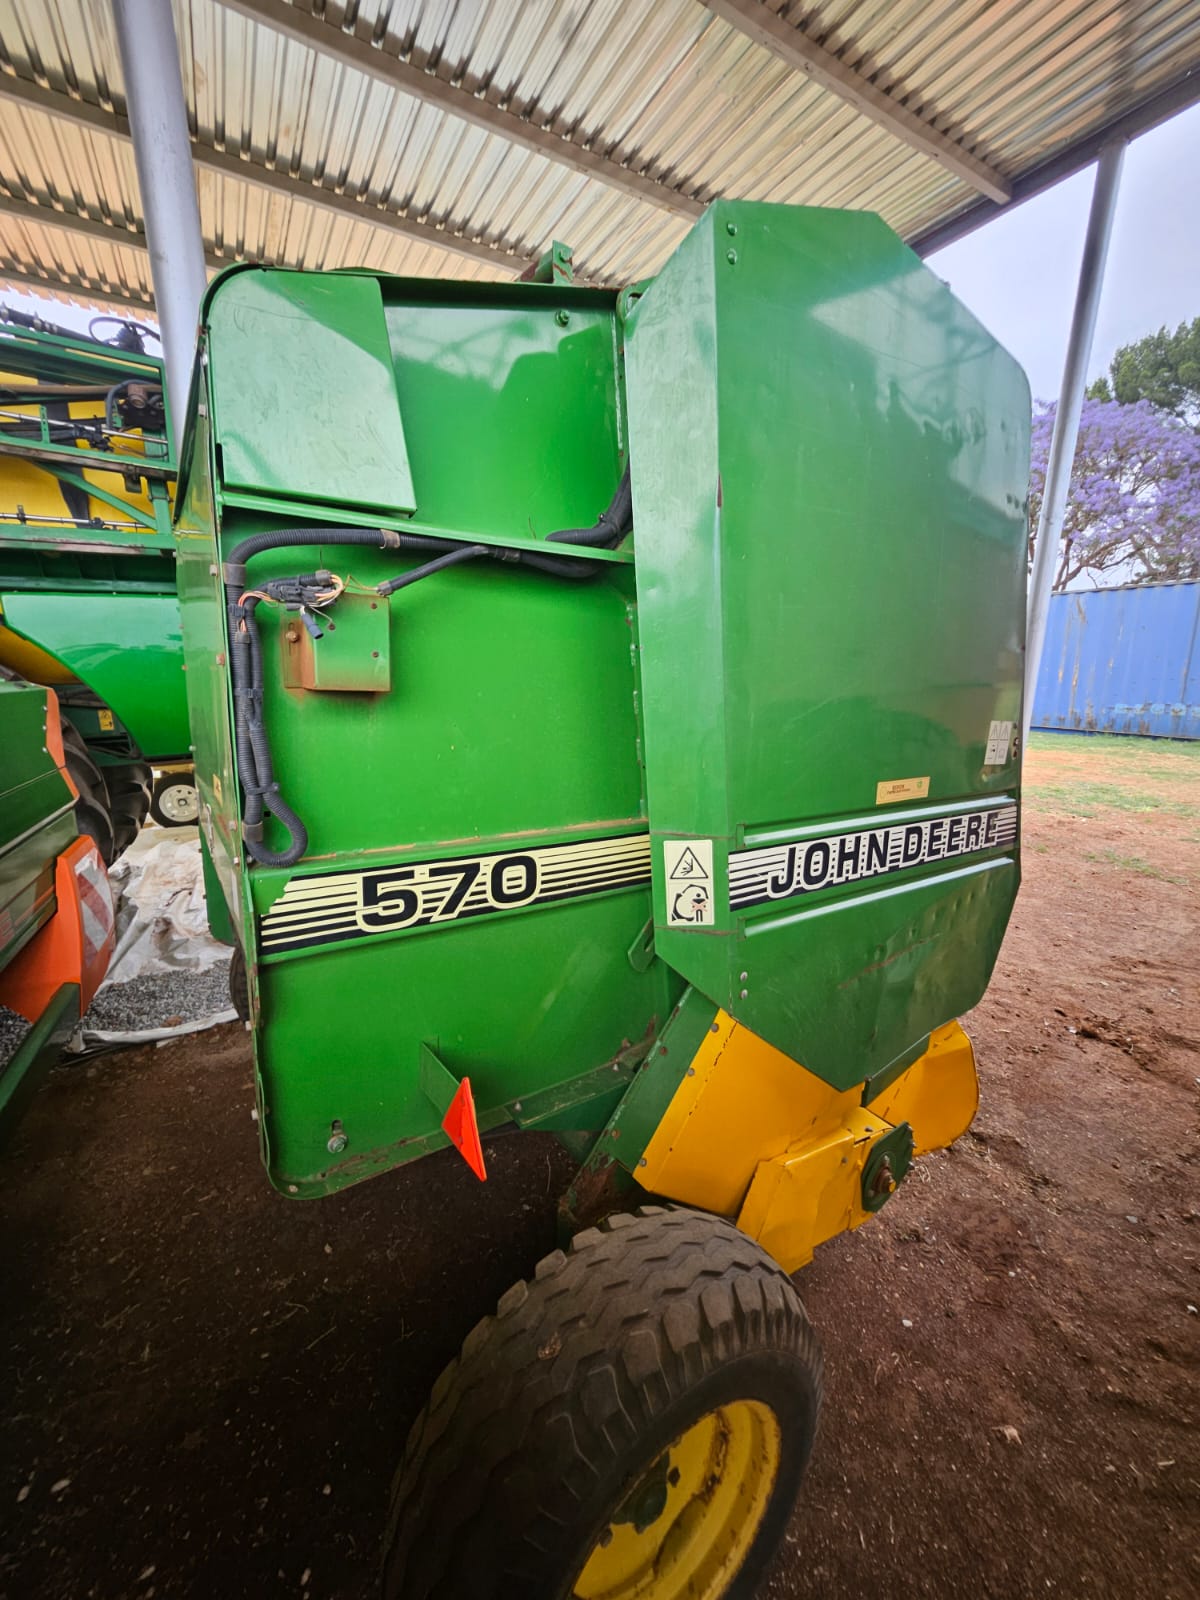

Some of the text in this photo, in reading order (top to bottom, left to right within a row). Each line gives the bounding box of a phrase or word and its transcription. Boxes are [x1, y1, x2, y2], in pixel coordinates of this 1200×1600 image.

[359, 854, 539, 929] 570
[769, 812, 1000, 895] JOHN DEERE
